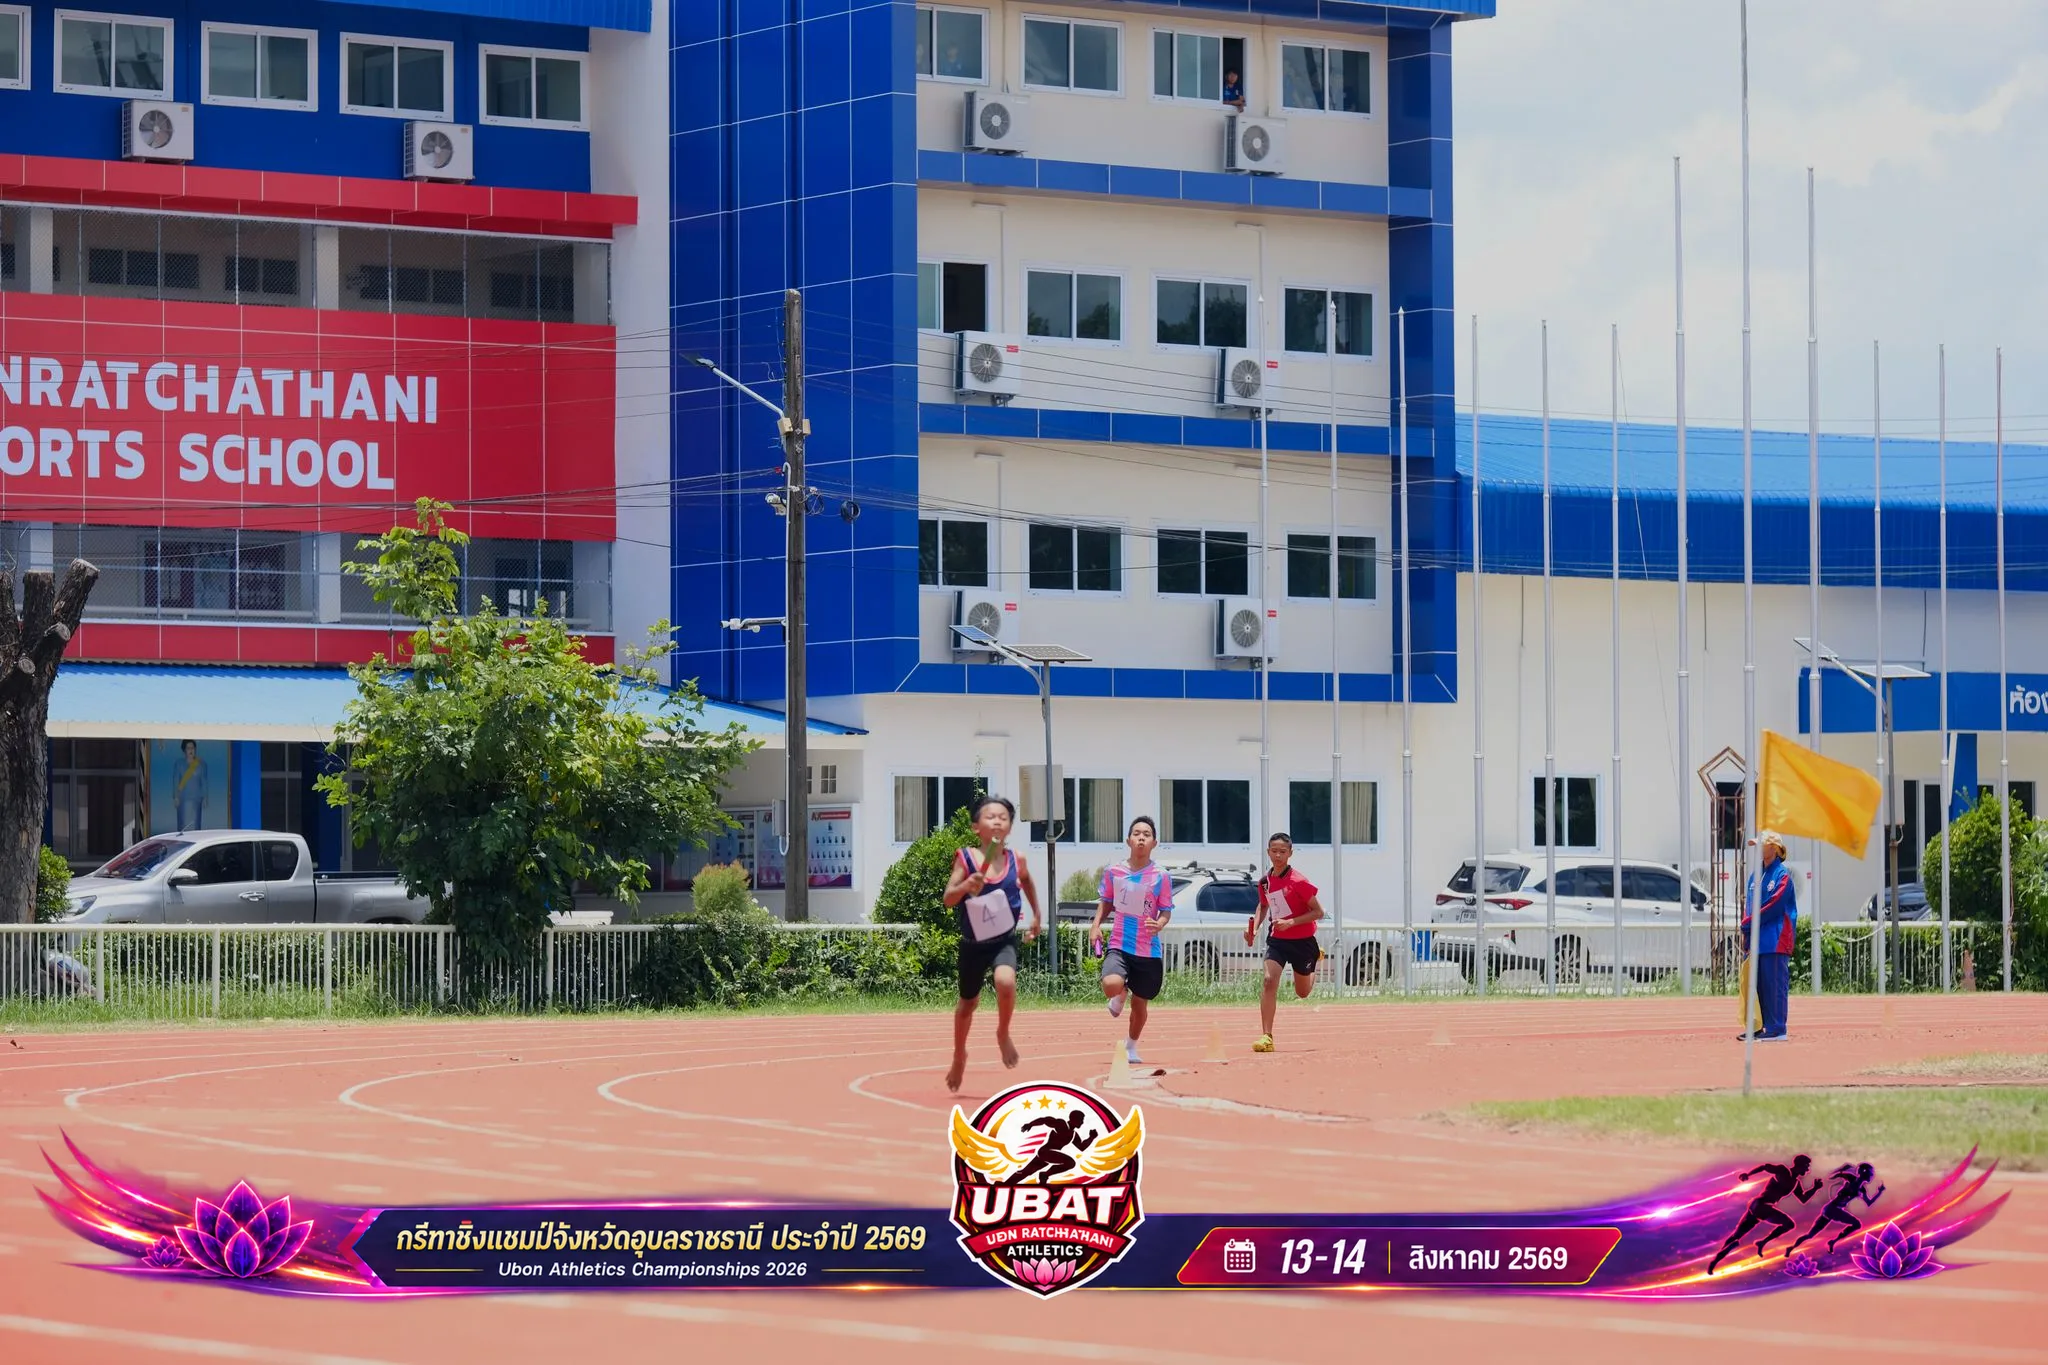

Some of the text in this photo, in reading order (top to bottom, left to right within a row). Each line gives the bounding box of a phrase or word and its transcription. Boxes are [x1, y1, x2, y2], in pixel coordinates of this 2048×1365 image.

[0, 425, 395, 490] ORTS SCHOOL
[982, 903, 997, 927] 4
